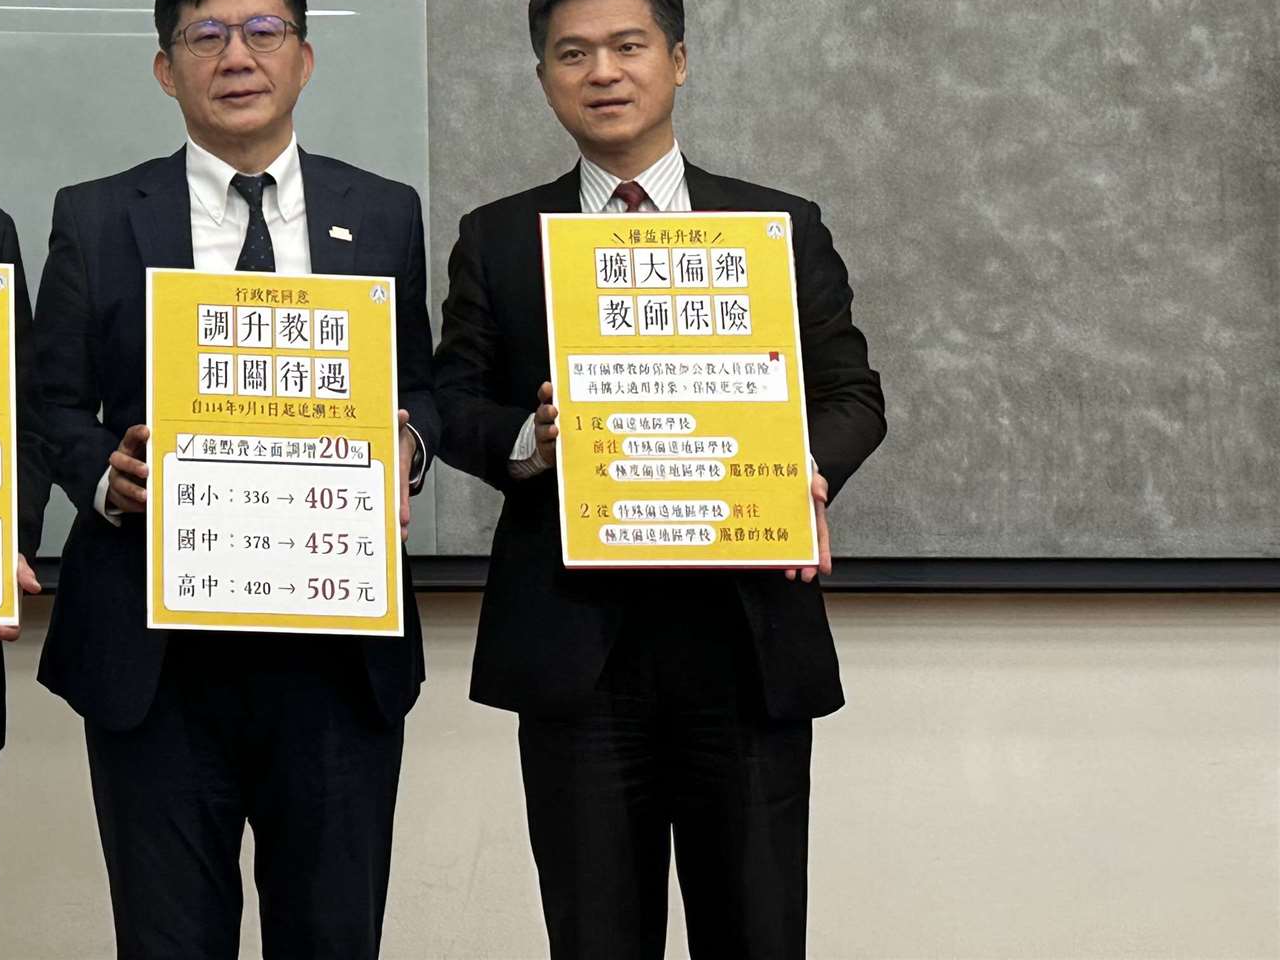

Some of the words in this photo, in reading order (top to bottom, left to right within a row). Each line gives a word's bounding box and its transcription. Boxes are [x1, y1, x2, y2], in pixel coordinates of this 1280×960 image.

[599, 252, 745, 283] 擴大偏鄉
[235, 287, 310, 304] 行政院同意
[603, 299, 749, 331] 教師保險
[203, 309, 345, 346] 調升教師
[201, 358, 348, 393] 相關待遇
[192, 399, 357, 420] 自114年9月1日起追溯生效
[202, 436, 364, 460] 鐘點費全面調增20%
[593, 440, 618, 454] 前往
[729, 463, 799, 478] 服務的教師
[304, 487, 373, 512] 405元
[580, 504, 590, 518] 2
[732, 503, 761, 519] 前往
[304, 533, 374, 557] 455元
[719, 527, 789, 543] 服務的教師
[306, 578, 375, 602] 505元
